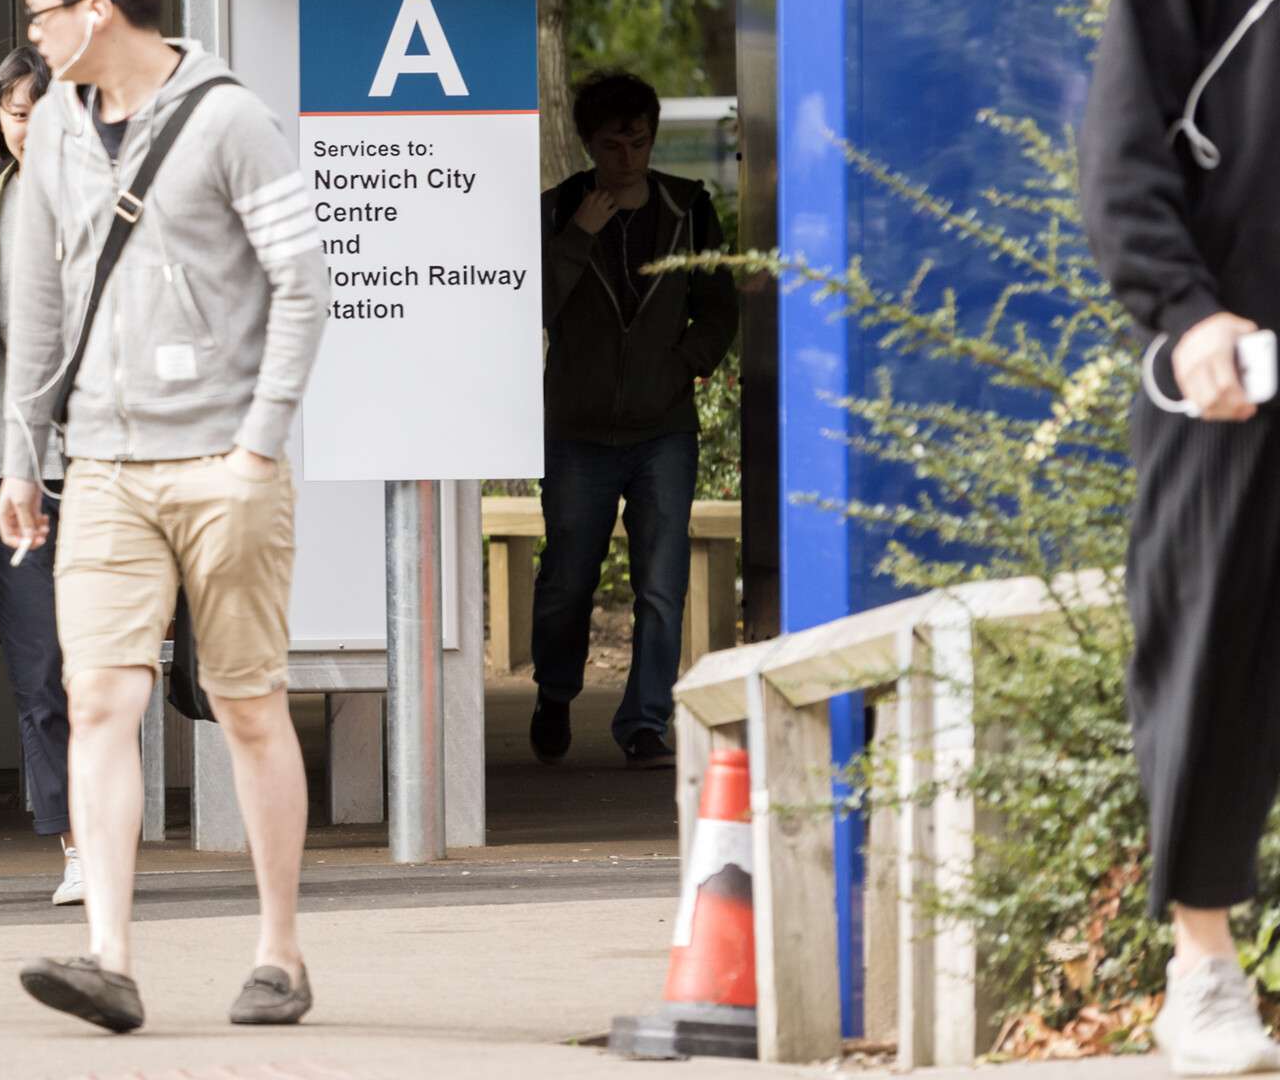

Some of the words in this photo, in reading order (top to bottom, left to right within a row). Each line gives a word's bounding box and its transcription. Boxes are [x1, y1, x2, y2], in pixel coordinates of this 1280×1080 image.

[313, 140, 401, 158] Services
[407, 141, 434, 157] to:
[314, 168, 417, 190] Norwich
[427, 168, 476, 194] City
[314, 201, 398, 222] Centre
[328, 265, 419, 287] orwich
[429, 265, 527, 291] Railway
[326, 298, 404, 320] tation
